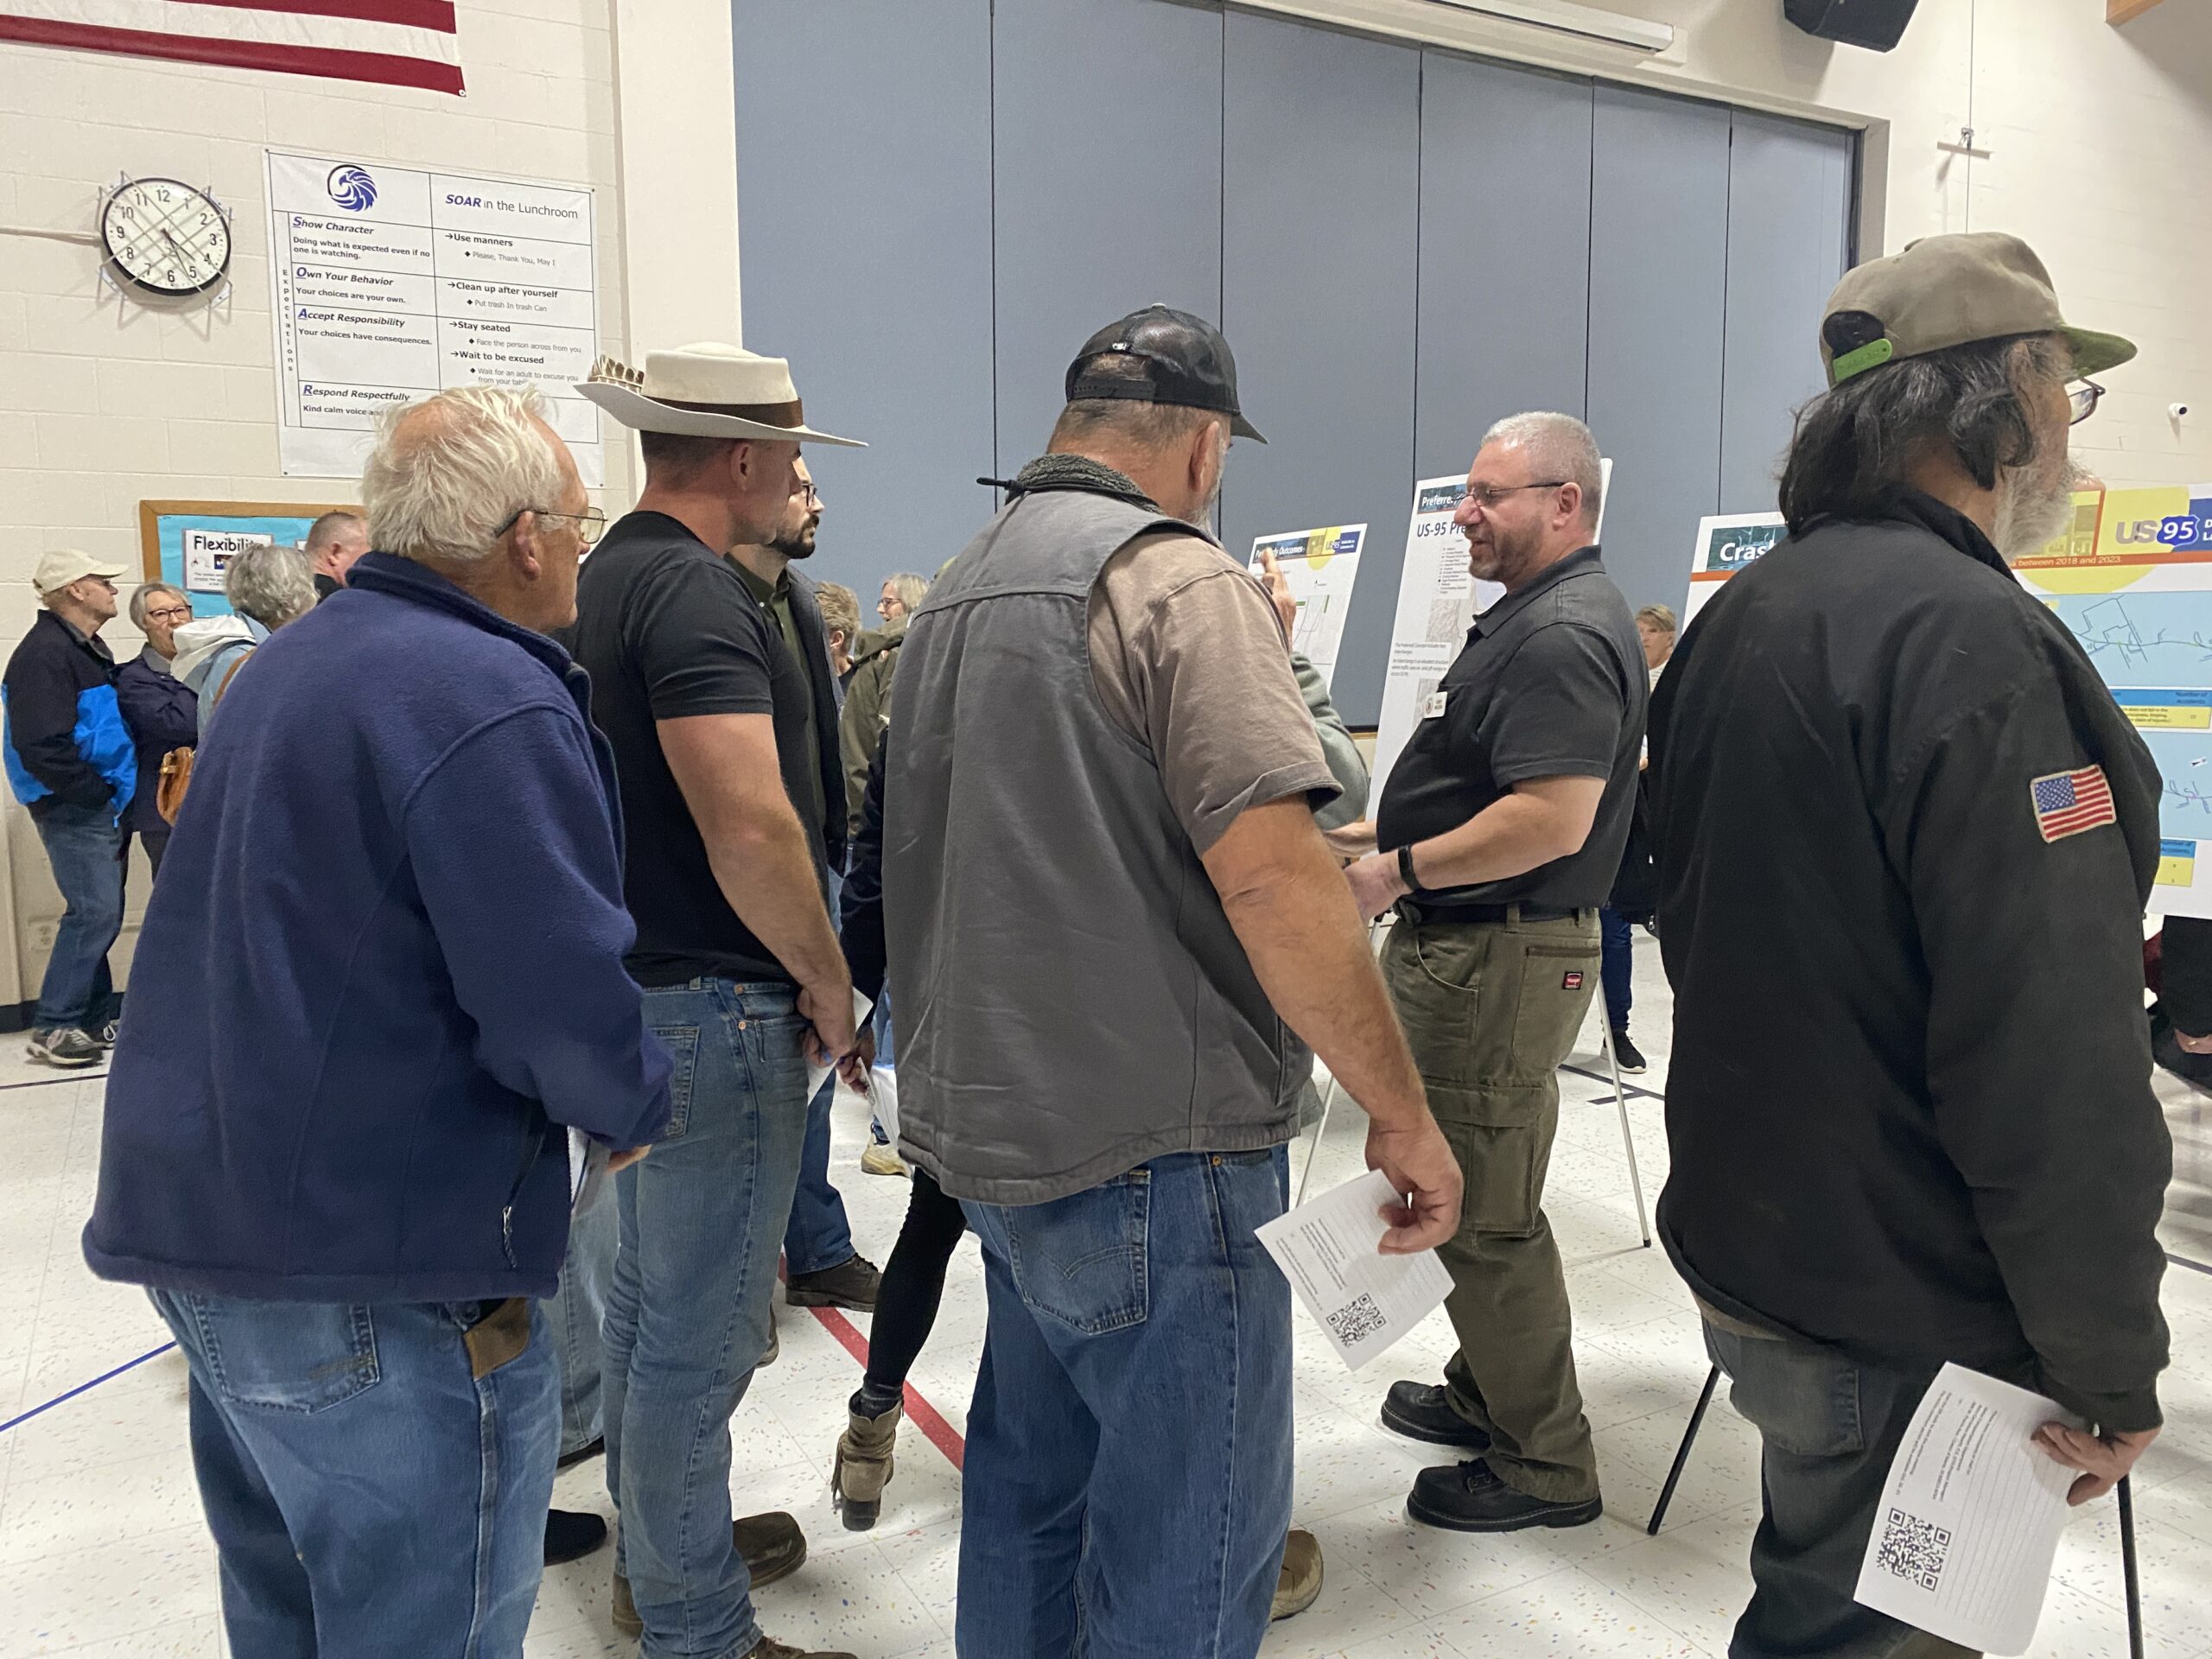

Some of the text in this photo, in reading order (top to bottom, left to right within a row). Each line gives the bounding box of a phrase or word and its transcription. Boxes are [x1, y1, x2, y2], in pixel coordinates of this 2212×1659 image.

[136, 193, 148, 207] 11
[156, 189, 171, 202] 12
[121, 207, 134, 219] 10
[445, 194, 578, 219] SOAR in the Lunchroom
[200, 213, 208, 226] 2
[292, 216, 374, 235] Show Character
[117, 226, 124, 238] 9
[209, 233, 217, 246] 3
[293, 236, 317, 247] Doing
[320, 239, 341, 248] what
[352, 244, 389, 253] expected
[454, 232, 513, 247] Use manners
[126, 247, 134, 259] 8
[321, 248, 361, 260] watching.
[473, 251, 496, 261] Please,
[498, 253, 519, 263] Thank
[144, 263, 152, 276] 7
[189, 266, 197, 278] 5
[296, 266, 394, 286] Own Your Behavior
[168, 270, 175, 283] 6
[296, 287, 316, 296] Your
[318, 289, 349, 298] choices
[365, 294, 385, 302] your
[456, 282, 481, 292] Clean
[498, 285, 520, 295] after
[522, 289, 558, 299] yourself
[474, 299, 486, 308] Put
[487, 300, 505, 308] trash
[297, 308, 405, 328] Accept Responsibility
[457, 321, 511, 333] Stay seated
[320, 329, 351, 339] choices
[353, 332, 372, 340] have
[374, 335, 432, 345] consequences.
[476, 338, 492, 346] Face
[506, 340, 529, 349] person
[531, 342, 551, 351] across
[552, 343, 568, 352] from
[459, 351, 544, 364] Wait to be excused
[495, 368, 505, 377] for
[516, 369, 532, 378] adult
[543, 372, 565, 380] excuse
[302, 385, 410, 402] Respond Respectfully
[303, 404, 321, 413] Kind
[1417, 522, 1446, 537] US-95
[2116, 520, 2158, 544] US
[2164, 521, 2195, 540] 95
[194, 536, 254, 552] Flexibili
[2018, 558, 2054, 567] between
[2056, 556, 2078, 565] 2018
